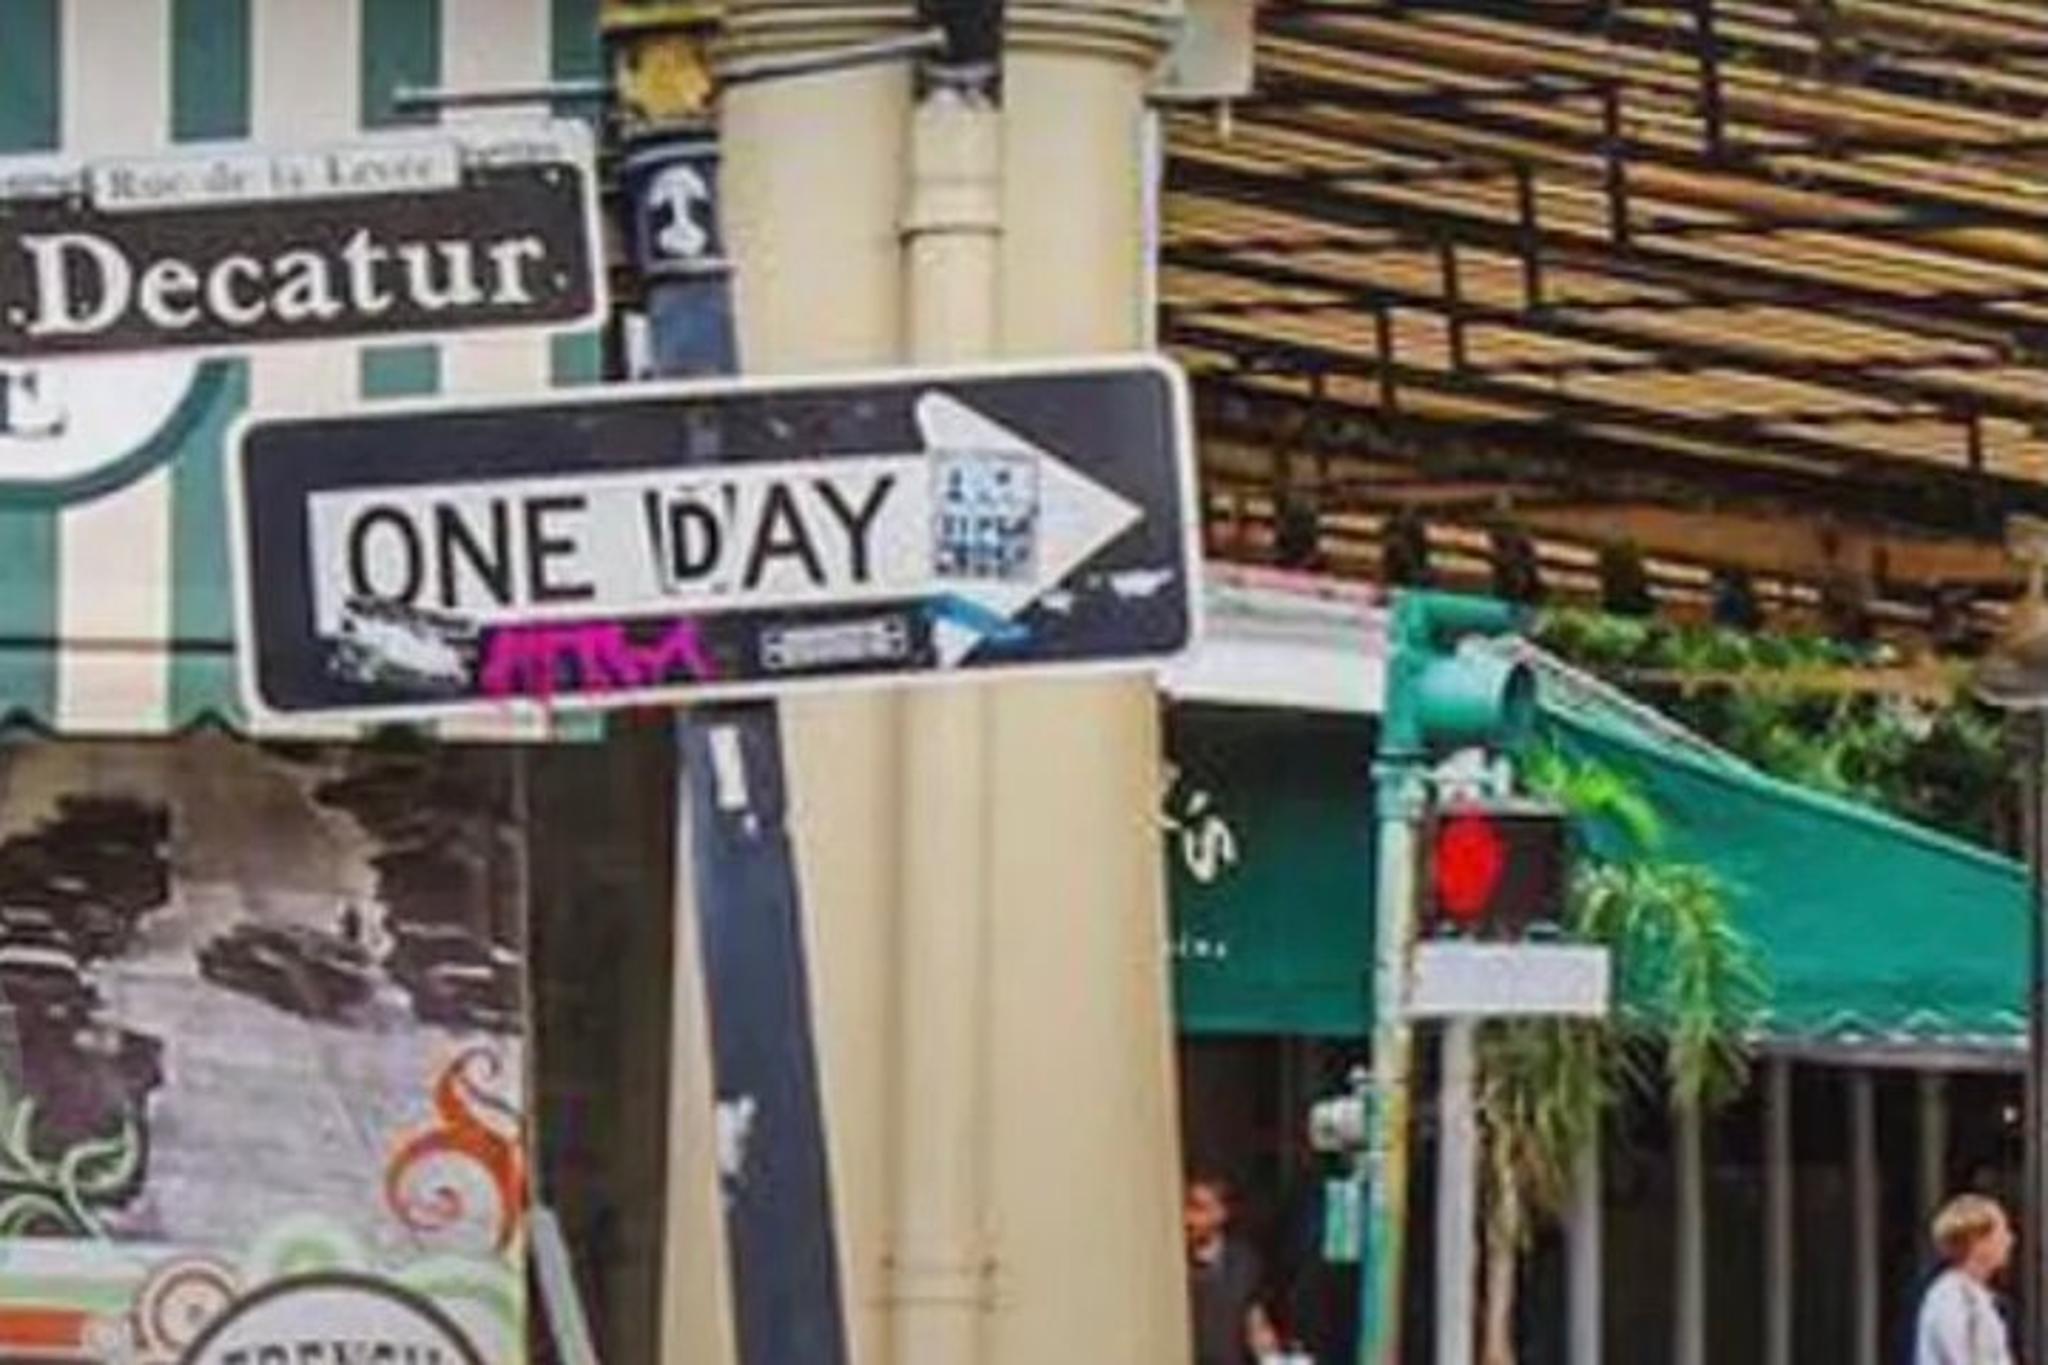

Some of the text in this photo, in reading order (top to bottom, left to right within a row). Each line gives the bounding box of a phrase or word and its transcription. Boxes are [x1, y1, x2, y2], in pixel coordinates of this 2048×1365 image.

[22, 228, 544, 335] Decatur
[347, 494, 597, 606] ONE
[668, 474, 895, 590] DAY
